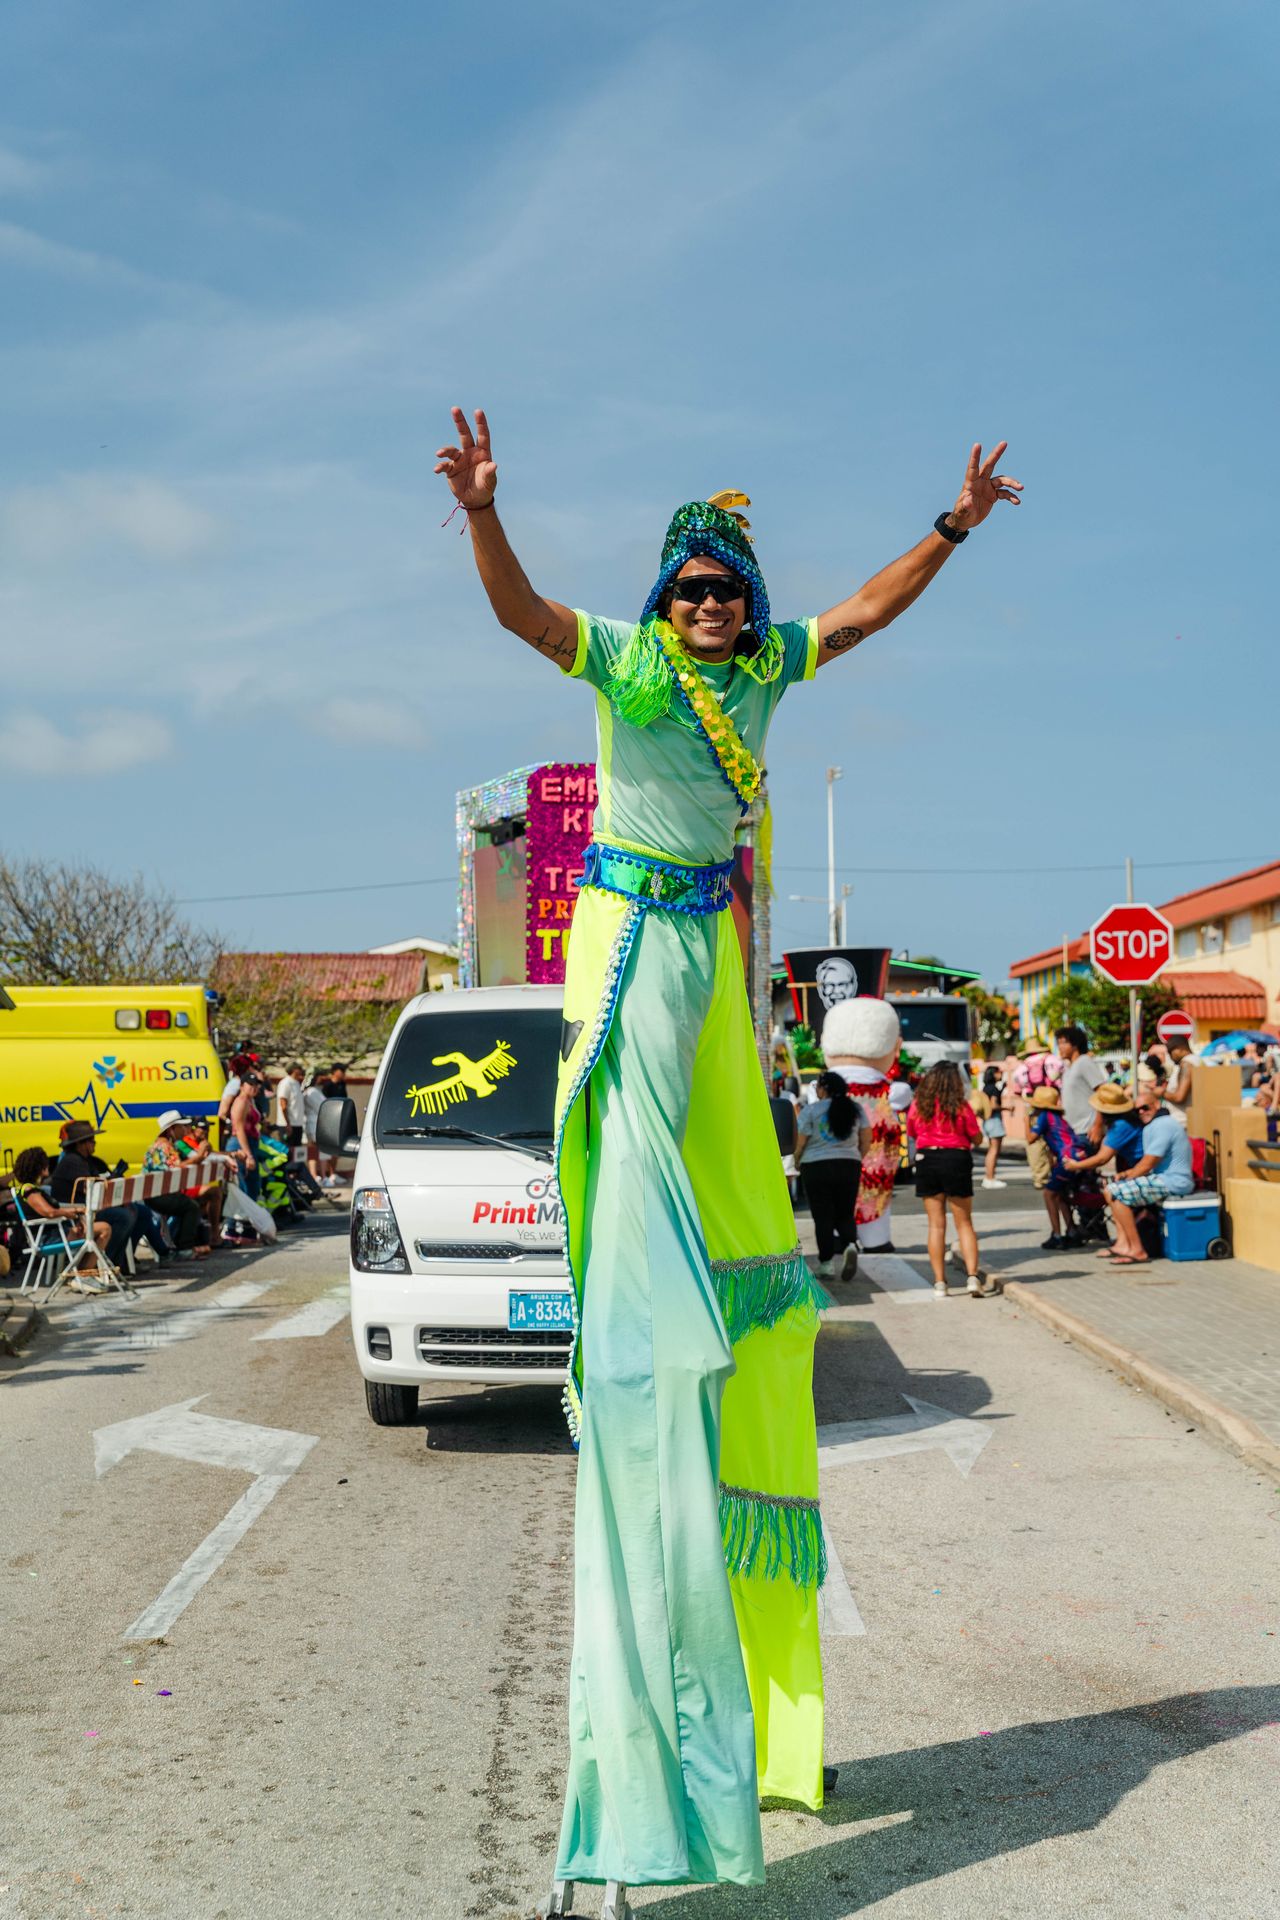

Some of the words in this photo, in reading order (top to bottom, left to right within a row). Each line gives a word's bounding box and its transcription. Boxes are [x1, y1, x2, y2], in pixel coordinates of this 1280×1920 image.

[1096, 929, 1168, 961] STOP
[131, 1060, 208, 1082] ImSan
[539, 1231, 556, 1241] we
